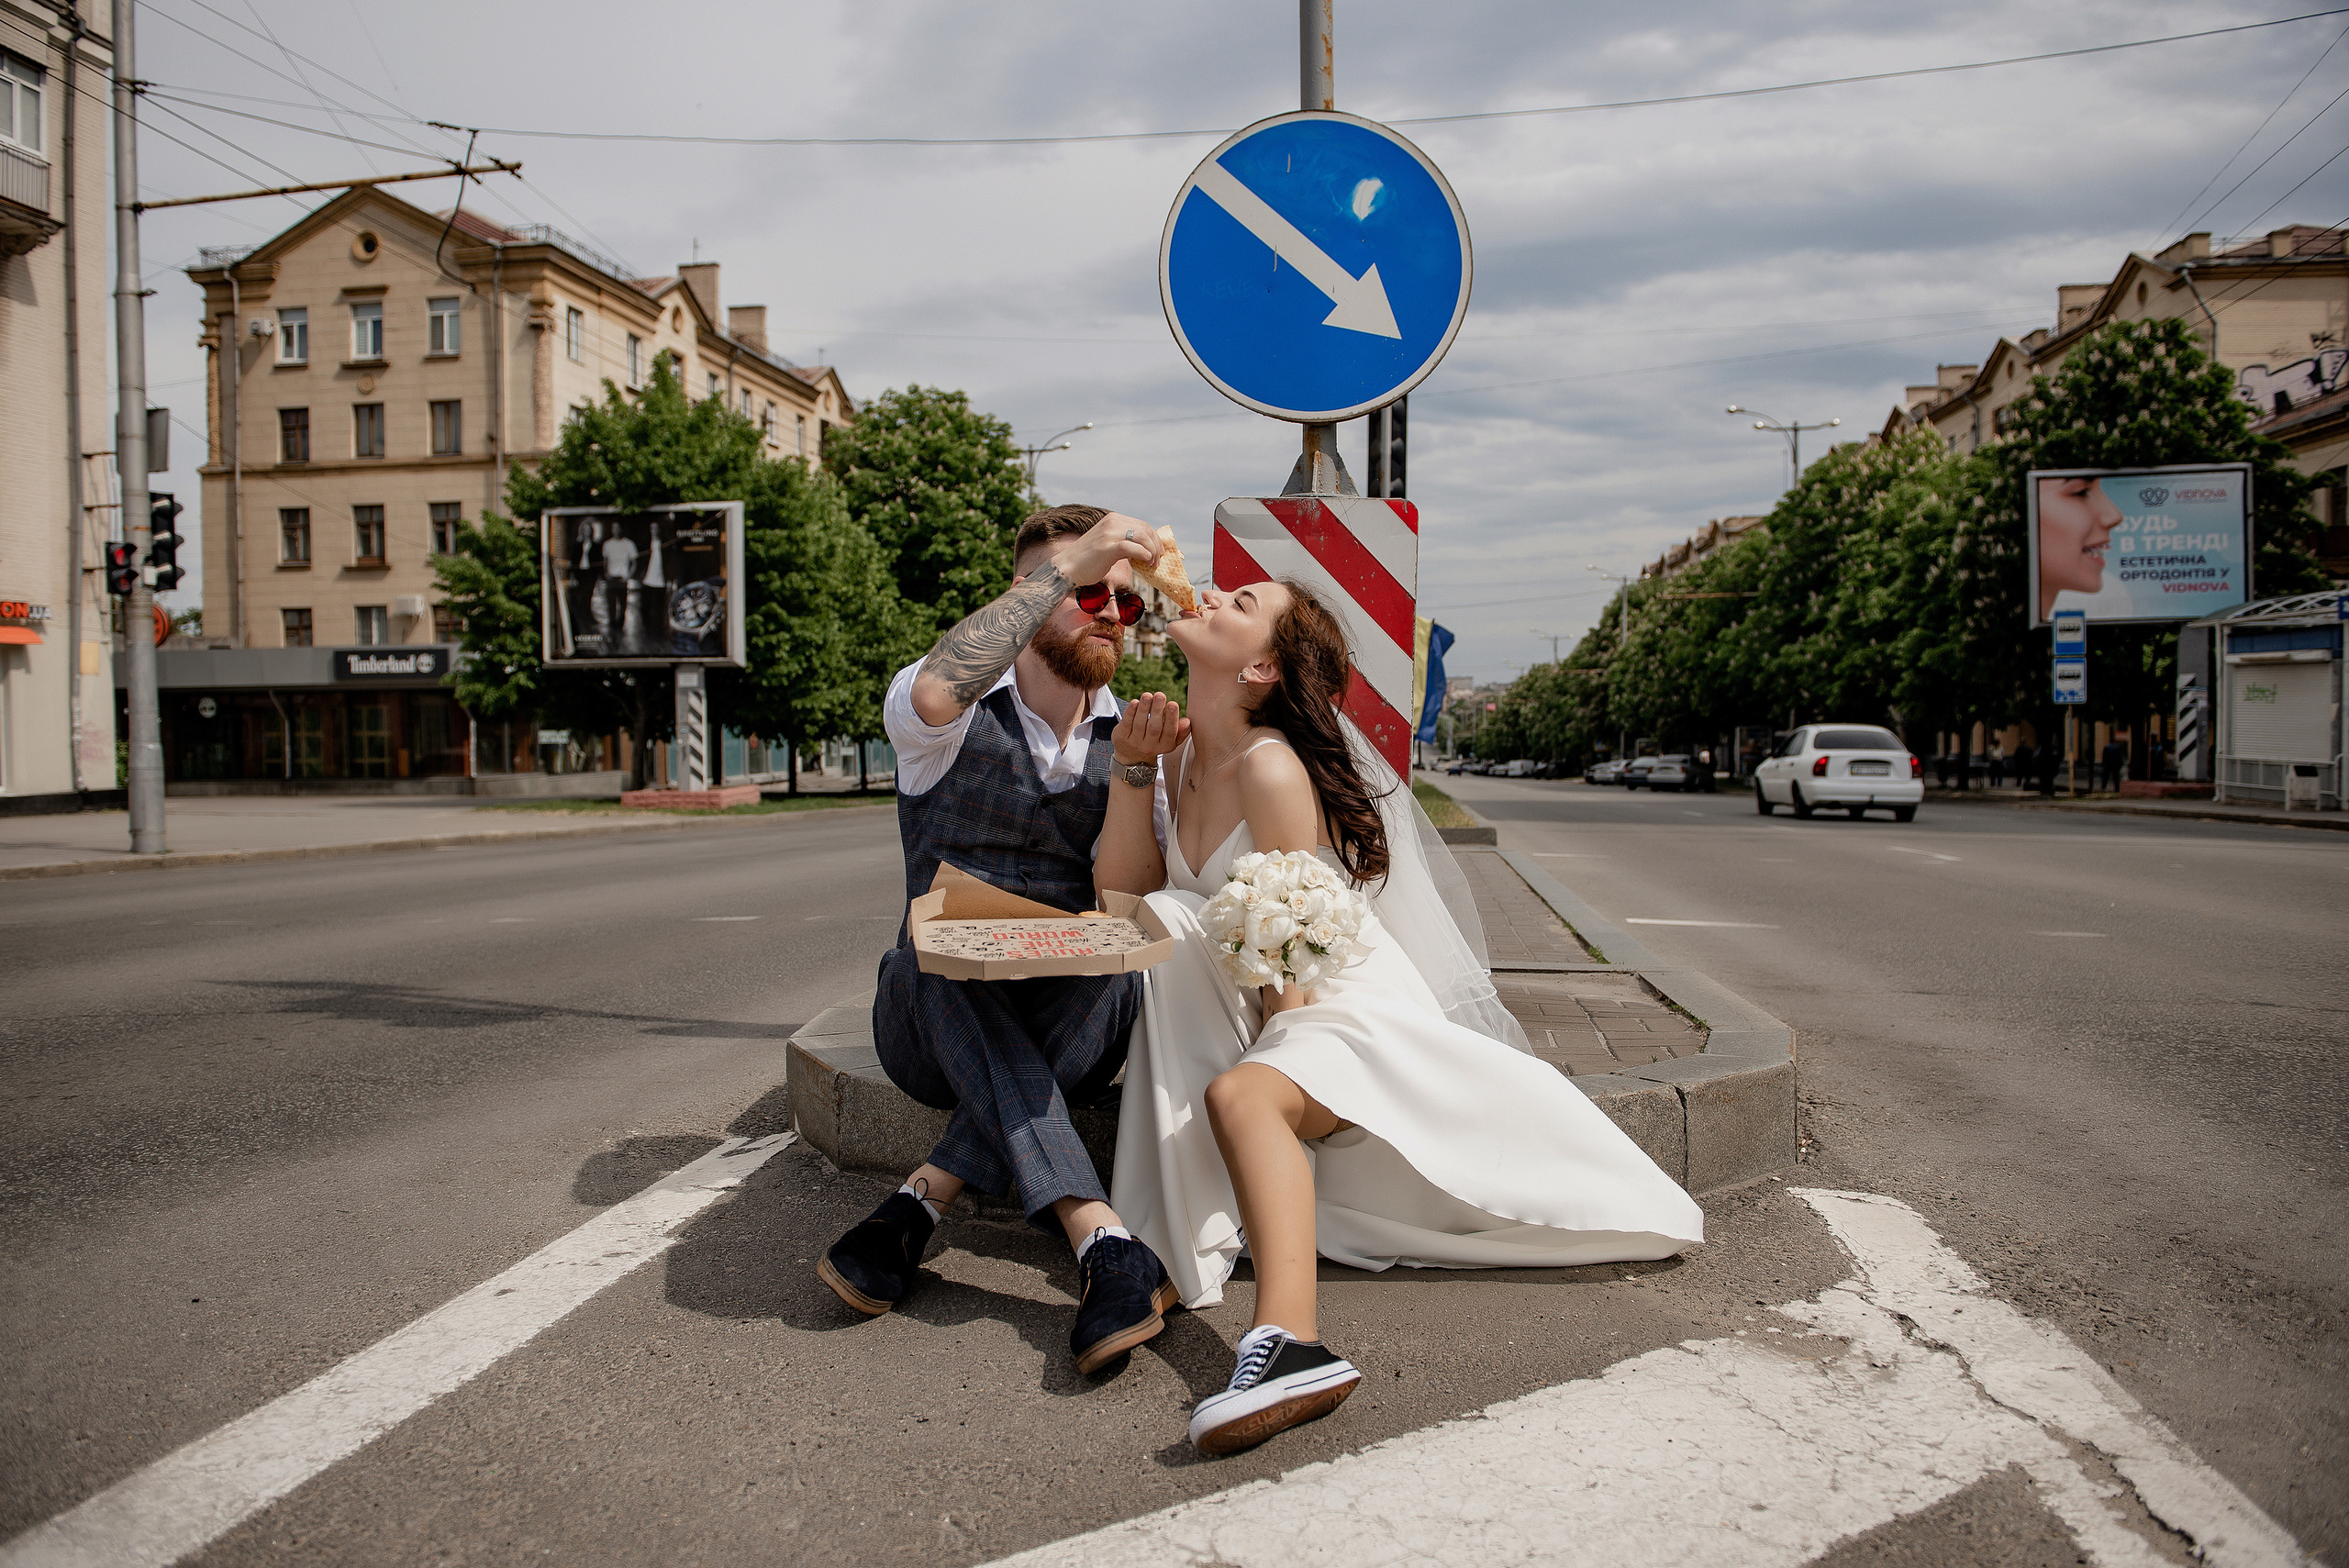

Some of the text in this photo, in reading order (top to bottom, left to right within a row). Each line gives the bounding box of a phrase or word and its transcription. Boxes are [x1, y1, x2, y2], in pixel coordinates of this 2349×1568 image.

[2121, 532, 2228, 552] В ТРЕНДІ
[2120, 554, 2207, 567] ЕСТЕТИЧНА
[2120, 567, 2231, 581] ОРТОДОНТІЯ У
[2162, 581, 2230, 594] VIDNOVA
[348, 654, 417, 673] Timberland
[993, 930, 1085, 940] WORLD
[1020, 940, 1069, 949] THE
[1008, 948, 1094, 958] RULES
